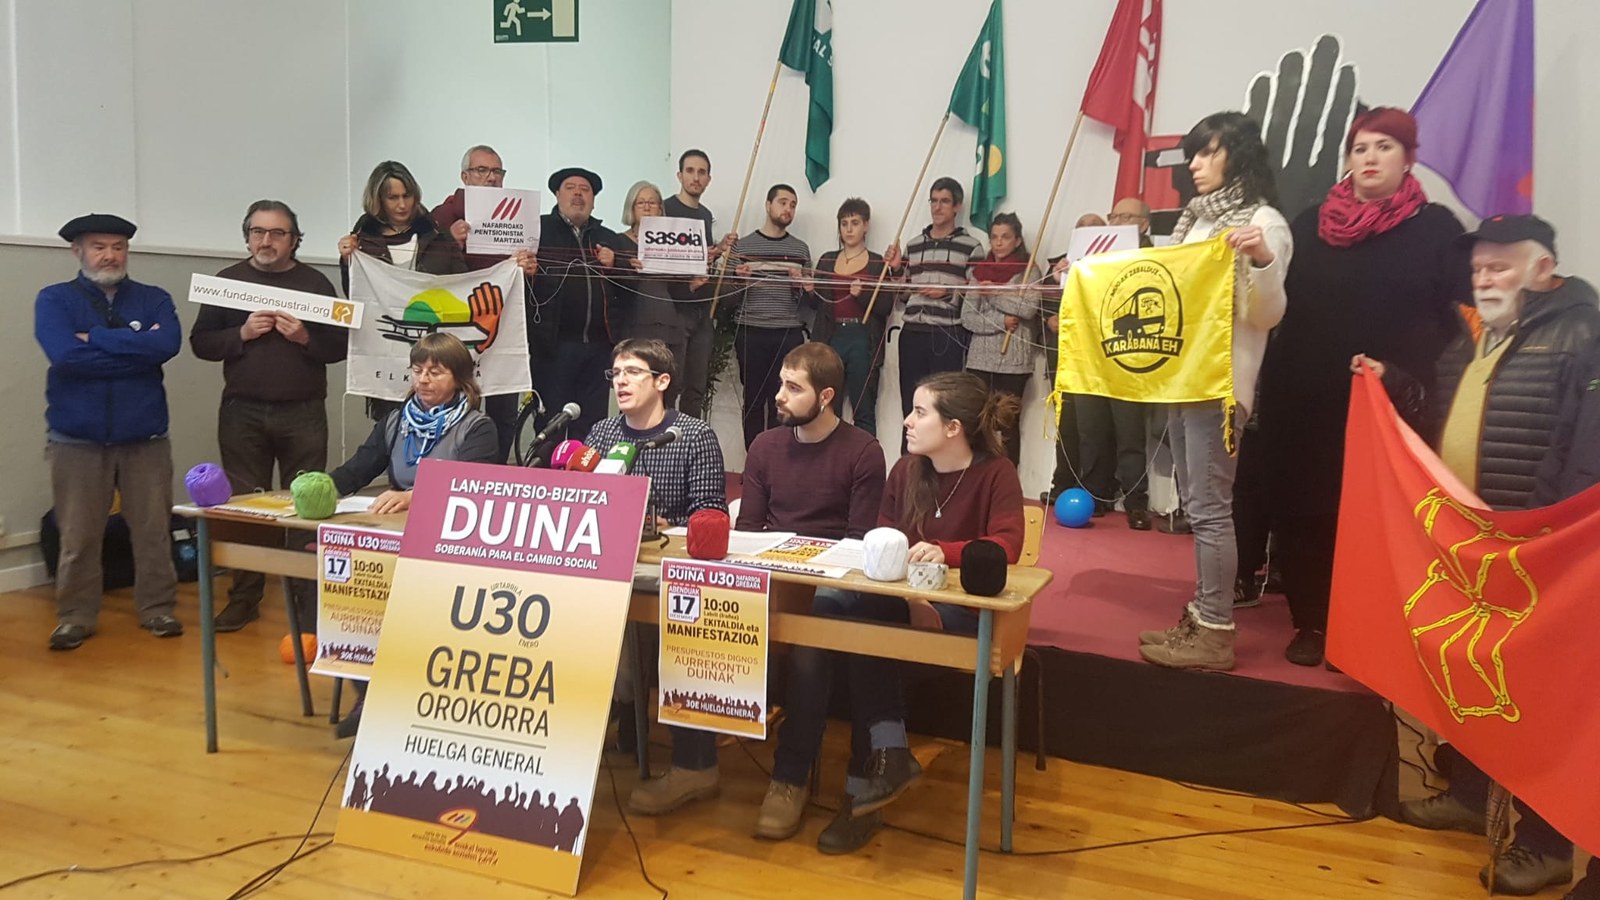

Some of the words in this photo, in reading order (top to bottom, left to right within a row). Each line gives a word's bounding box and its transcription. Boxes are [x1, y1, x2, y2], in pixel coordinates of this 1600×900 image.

[474, 229, 524, 237] PENTSIONISTAK
[482, 222, 524, 230] NAFARROAKO
[493, 236, 524, 244] MARTXAN
[645, 228, 702, 246] sasoia
[193, 284, 330, 317] www.fundacionsustrai.org
[1105, 337, 1160, 355] KARABANA
[1162, 340, 1178, 353] EH
[450, 477, 608, 506] LAN-PENTSIO-BIZITZA
[440, 496, 602, 556] DUINA
[323, 532, 355, 546] DUINA
[358, 535, 380, 550] U30
[434, 543, 487, 558] SOBERANÍA
[488, 549, 512, 561] PARA
[513, 551, 525, 562] EL
[526, 553, 563, 566] CAMBIO
[564, 556, 598, 570] SOCIAL
[328, 558, 347, 575] 17
[353, 559, 384, 574] 10:00
[667, 568, 705, 583] DUINA
[709, 571, 735, 586] U30
[668, 585, 699, 596] ABENDUAK
[450, 585, 551, 640] U30
[672, 594, 696, 615] 17
[703, 598, 739, 614] 10:00
[667, 622, 759, 647] MANIFESTAZIOA
[703, 618, 745, 631] EKITALDIA
[746, 623, 760, 633] eta
[518, 638, 540, 649] ENERO
[666, 644, 726, 660] PRESUPUESTOS
[727, 653, 759, 665] DIGNOS
[426, 645, 555, 705] GREBA
[674, 655, 751, 676] AURREKONTU
[687, 666, 735, 685] DUINAK
[417, 692, 549, 738] OROKORRA
[685, 699, 700, 709] 30E
[700, 701, 725, 714] HUELGA
[725, 705, 756, 719] GENERAL
[405, 734, 467, 763] HUELGA
[471, 746, 544, 776] GENERAL
